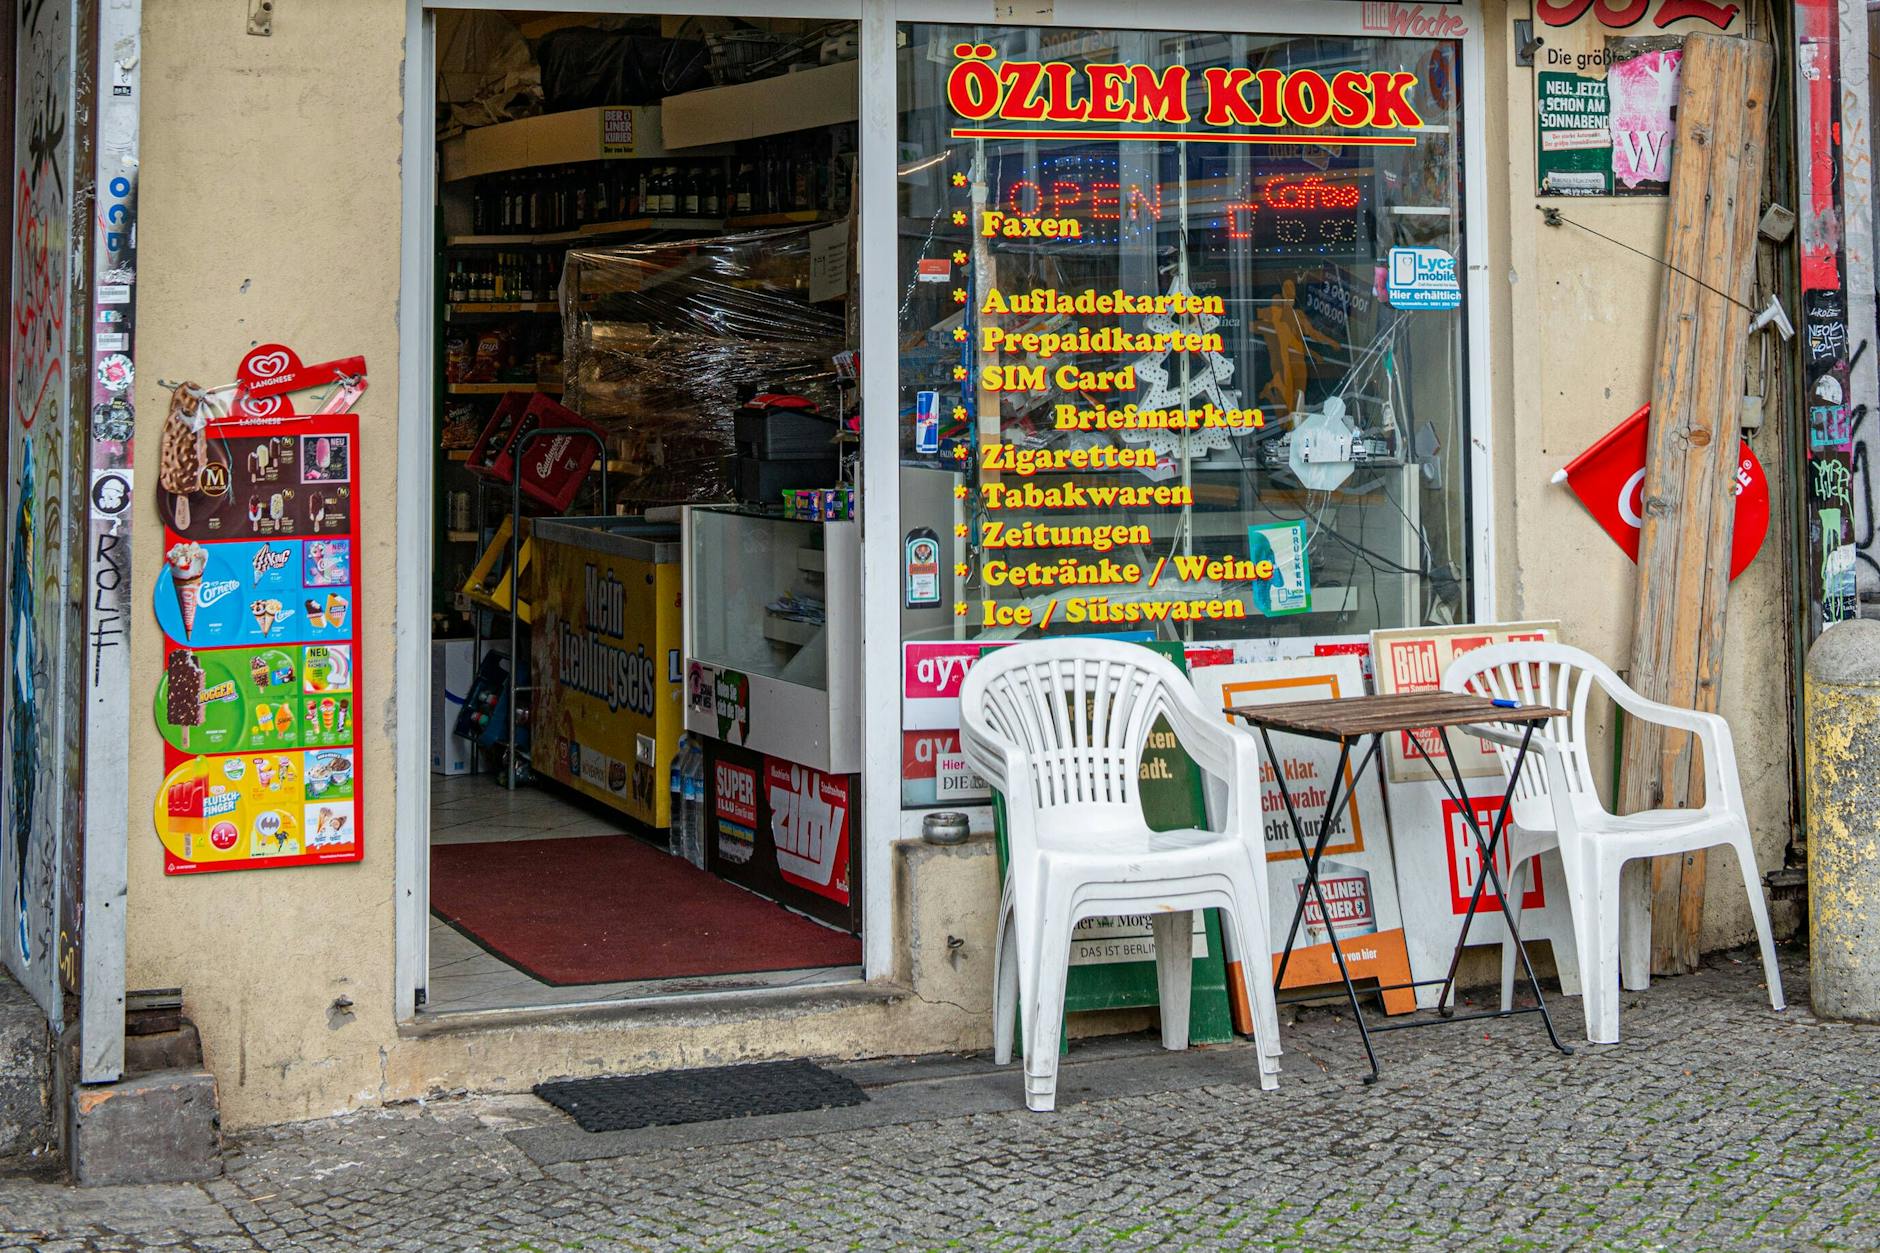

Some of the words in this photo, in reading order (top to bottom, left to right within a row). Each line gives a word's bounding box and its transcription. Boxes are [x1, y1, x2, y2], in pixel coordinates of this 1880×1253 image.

[1387, 4, 1469, 37] Woche
[1547, 49, 1571, 64] Die
[947, 43, 1189, 123] ÖZLEM
[1205, 68, 1424, 128] KIOSK
[1546, 81, 1573, 95] NEU:
[1574, 82, 1606, 97] JETZT
[1546, 97, 1585, 112] SCHON
[1587, 98, 1606, 113] AM
[1541, 113, 1609, 129] SONNABEND
[1618, 130, 1669, 172] W
[1009, 181, 1162, 220] OPEN
[1264, 177, 1360, 208] Coffee
[981, 211, 1082, 238] Faxen
[1418, 254, 1457, 272] Lyca
[1418, 270, 1457, 282] mobile
[981, 288, 1225, 315] Aufladekarten
[1389, 290, 1412, 300] Hier
[1414, 289, 1462, 301] erhältlich
[981, 327, 1224, 357] Prepaidkarten
[250, 375, 292, 389] LANGNESE
[981, 365, 1046, 391] SIM
[1055, 365, 1136, 391] Card
[1054, 403, 1265, 430] Briefmarken
[981, 443, 1158, 475] Zigaretten
[981, 482, 1194, 509] Tabakwaren
[981, 521, 1151, 550] Zeitungen
[981, 559, 1141, 586] Getränke
[1173, 555, 1274, 583] Weine
[197, 580, 240, 608] Cornetto
[585, 564, 624, 638] Mein
[981, 599, 1033, 628] Ice
[1065, 597, 1246, 625] Süsswaren
[310, 648, 328, 657] NEU
[1394, 646, 1438, 684] Bild
[560, 620, 655, 717] Lieblingseis
[943, 760, 964, 769] Hier
[1284, 758, 1318, 780] klar.
[716, 767, 754, 806] SUPER
[943, 776, 968, 790] DIE
[1081, 947, 1102, 958] DAS
[1105, 945, 1119, 956] IST
